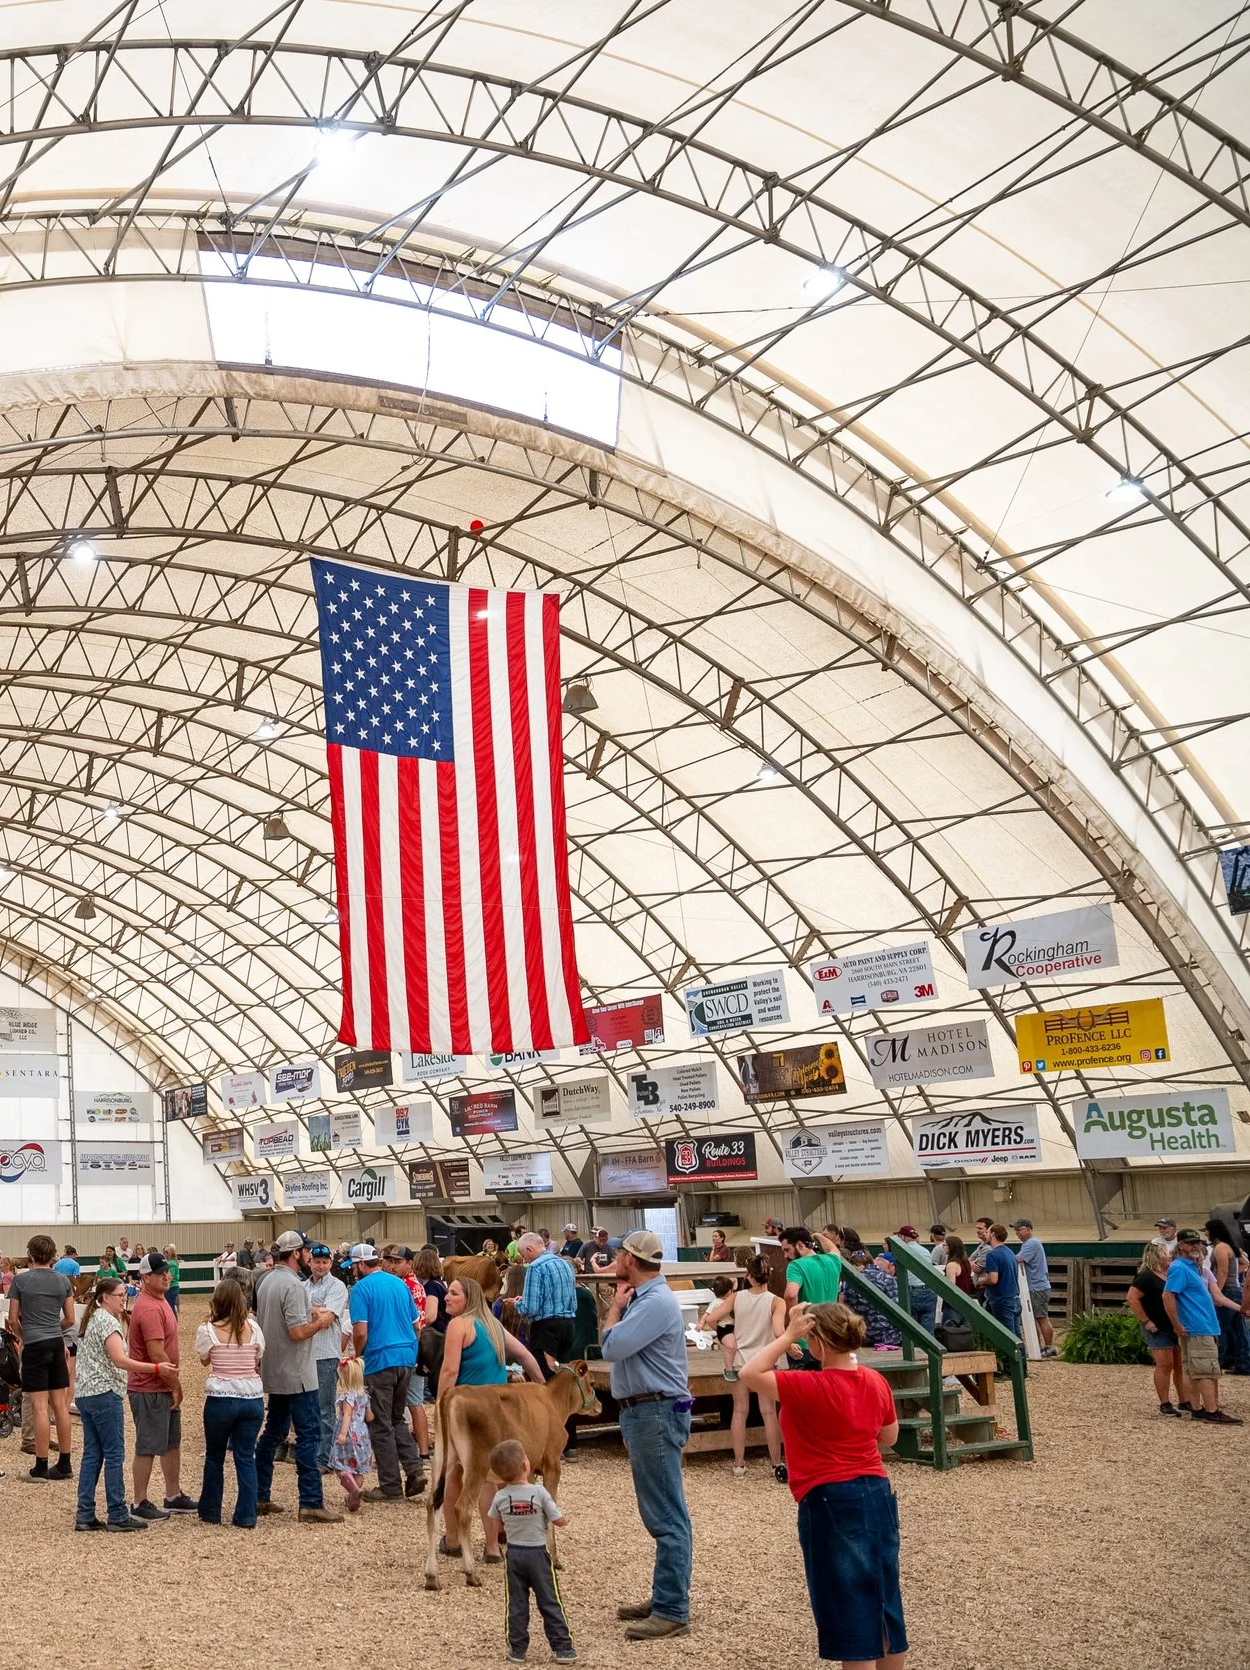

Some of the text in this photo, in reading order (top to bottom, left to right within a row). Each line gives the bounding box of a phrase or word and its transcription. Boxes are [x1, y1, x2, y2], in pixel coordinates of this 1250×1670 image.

[842, 947, 928, 969] AUTO PAINT AND SUPPLY CORP.
[980, 927, 1089, 979] Rockingham
[863, 957, 921, 972] SOUTH MAIN STREET
[1015, 955, 1102, 977] Cooperative
[848, 964, 927, 983] HARRISONBURG, VA 22801
[883, 975, 909, 985] 433-2471
[752, 978, 772, 988] Working
[913, 983, 934, 998] 3M
[753, 989, 771, 997] protect
[704, 993, 749, 1019] SWCD
[753, 997, 772, 1006] Valley's
[758, 1014, 783, 1023] resources
[927, 1027, 973, 1043] HOTEL
[1110, 1028, 1132, 1040] LLC
[870, 1033, 912, 1067] M
[917, 1039, 988, 1058] MADISON
[1061, 1042, 1122, 1056] 1-800-433-6236
[1052, 1053, 1132, 1068] www.profence.org
[4, 1069, 59, 1078] SENTARA
[276, 1069, 311, 1083] see-mor
[417, 1069, 430, 1077] BOOK
[430, 1066, 451, 1075] COMPANY
[888, 1065, 974, 1083] HOTELMADISON.COM
[562, 1084, 599, 1097] DutchWay
[669, 1099, 716, 1113] 540-249-8900
[396, 1118, 410, 1130] CYK
[1084, 1101, 1218, 1140] Augusta
[828, 1127, 882, 1138] valleystructures.com
[1149, 1128, 1221, 1151] Health
[918, 1131, 959, 1152] DICK
[682, 1150, 691, 1165] 33
[702, 1140, 745, 1161] Route 33
[625, 1156, 637, 1164] FFA
[638, 1154, 654, 1164] Barn
[705, 1157, 746, 1167] BUILDINGS
[991, 1155, 1009, 1164] Jeep
[237, 1178, 269, 1206] WHSV 3
[284, 1182, 329, 1194] Skyline Roofing Inc.
[347, 1176, 386, 1202] Cargill
